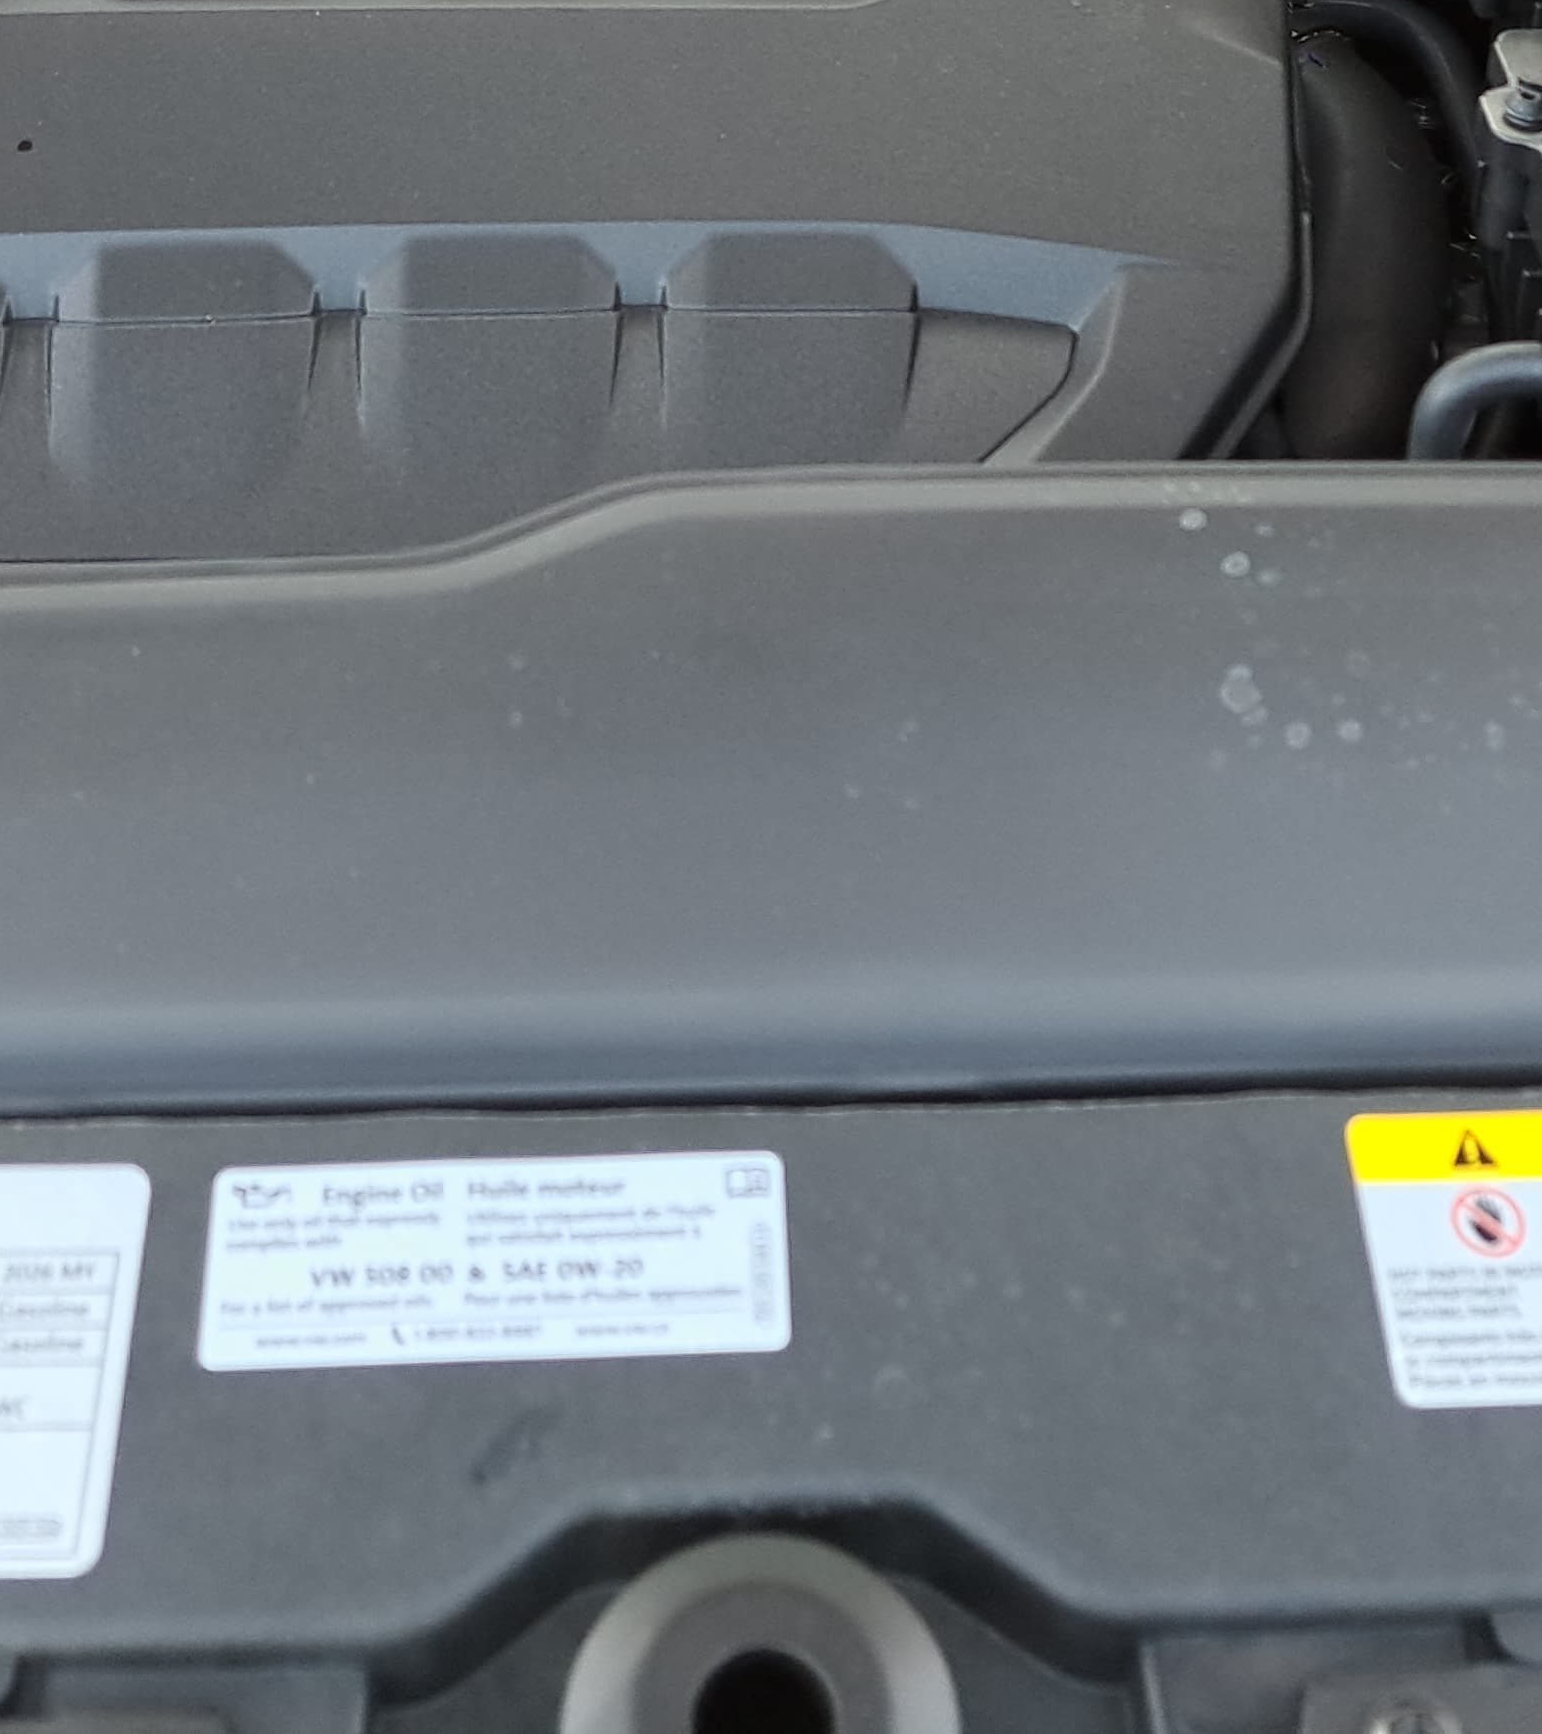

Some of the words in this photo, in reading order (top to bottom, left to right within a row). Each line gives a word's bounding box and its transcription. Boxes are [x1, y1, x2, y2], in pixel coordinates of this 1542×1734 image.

[321, 1182, 403, 1212] Engine
[410, 1180, 444, 1205] Oil
[466, 1178, 529, 1201] Huile
[536, 1176, 627, 1200] moteur
[309, 1264, 356, 1288] VW
[363, 1263, 410, 1287] 508
[419, 1262, 456, 1286] 00
[501, 1260, 550, 1284] SAE
